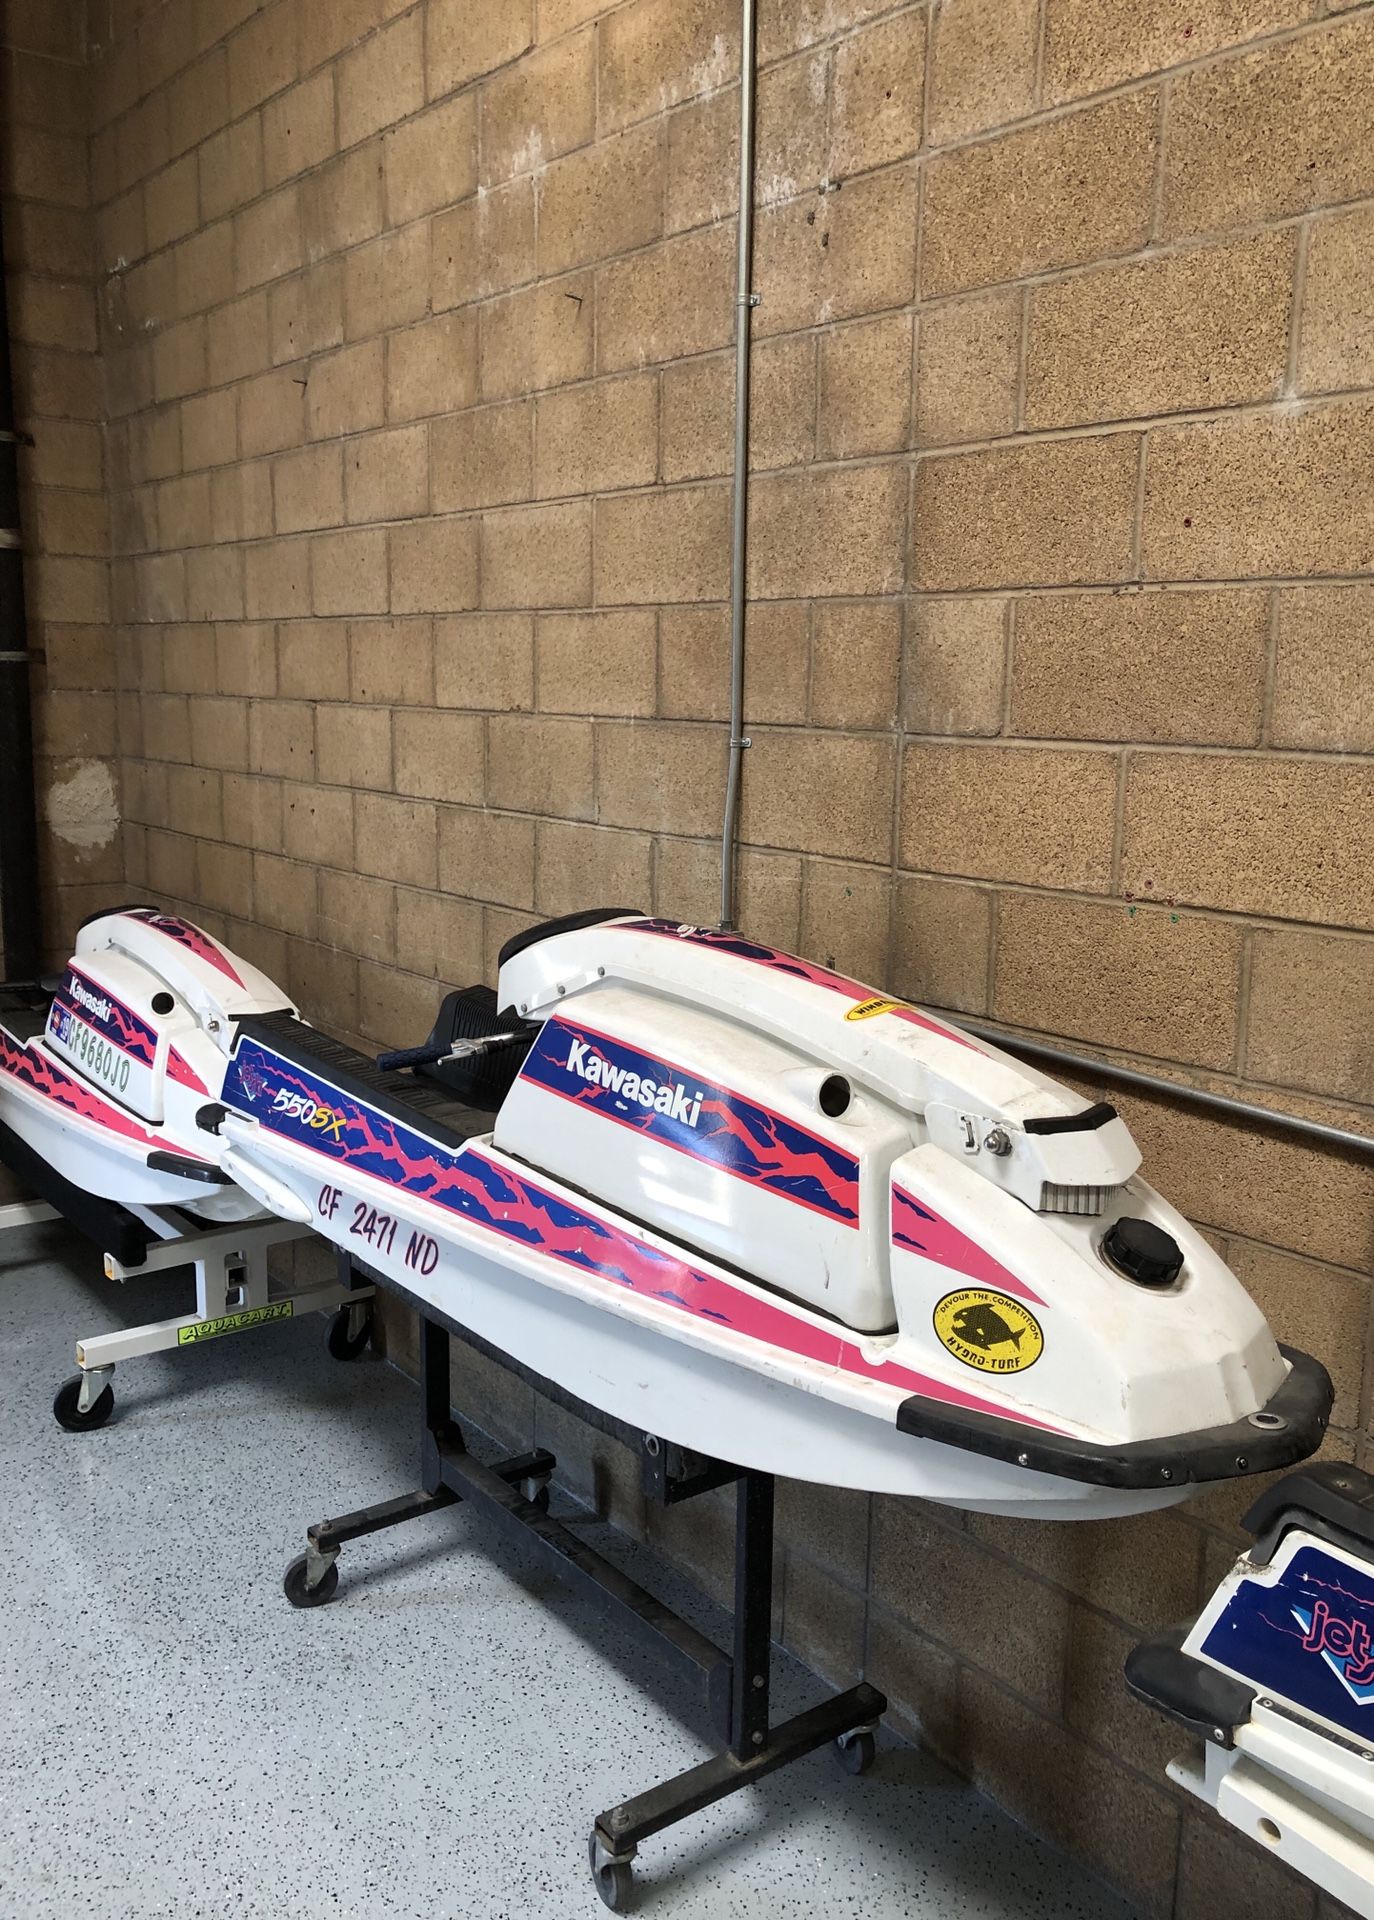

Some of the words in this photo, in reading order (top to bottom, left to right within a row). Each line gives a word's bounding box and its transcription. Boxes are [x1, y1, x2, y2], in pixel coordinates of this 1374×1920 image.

[69, 975, 112, 1022] Kawasaki
[566, 1038, 703, 1128] Kawasaki
[272, 1087, 347, 1142] 550SX
[318, 1184, 342, 1220] CF
[350, 1202, 398, 1255] 2471
[405, 1231, 439, 1276] ND
[182, 1303, 287, 1341] AQUACART
[940, 1292, 970, 1314] DEVOUR
[973, 1292, 989, 1301] THE
[992, 1295, 1039, 1340] COMPETITION
[947, 1336, 1022, 1370] HYDRO-TURF
